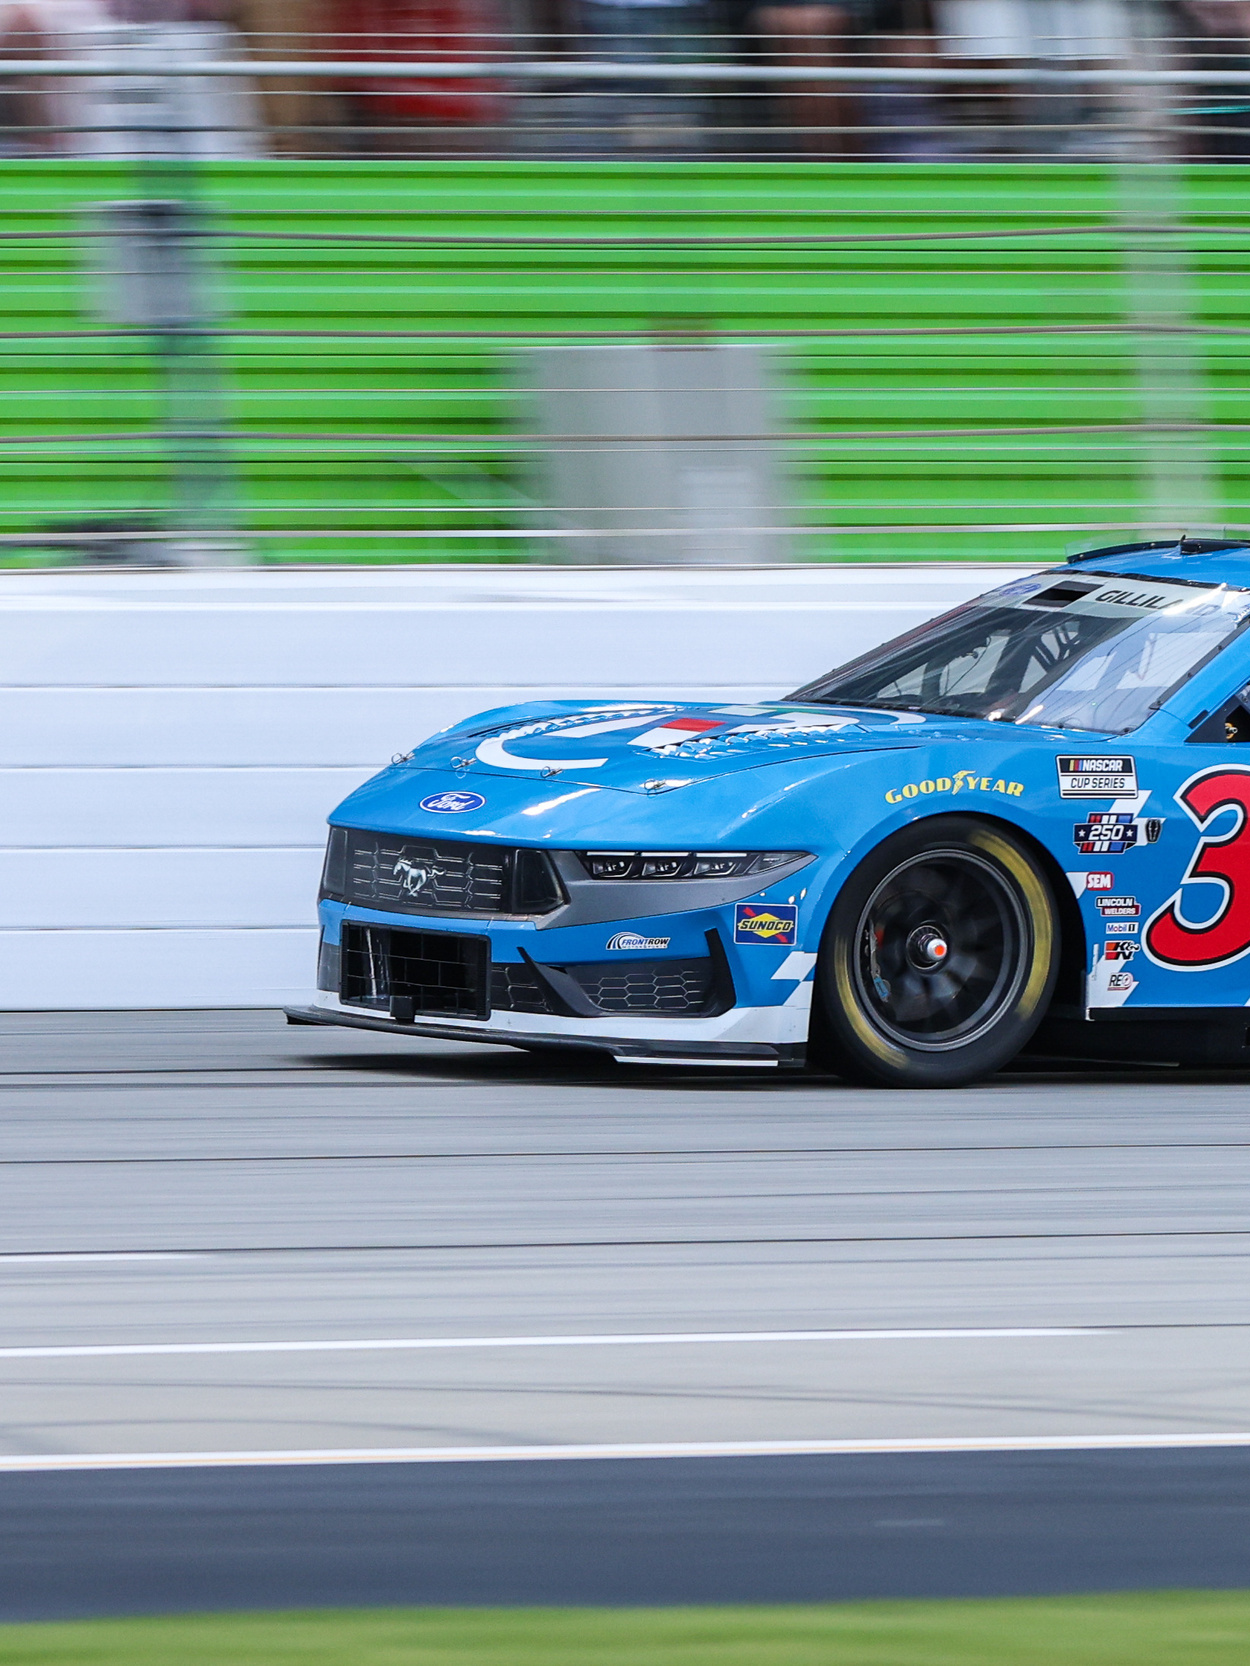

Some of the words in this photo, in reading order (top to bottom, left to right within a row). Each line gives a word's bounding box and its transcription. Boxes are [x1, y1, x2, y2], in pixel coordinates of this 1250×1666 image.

[1094, 589, 1221, 617] GILLILAD
[1082, 759, 1123, 771] NASCAR
[885, 770, 1025, 804] GOODYEAR
[1070, 778, 1090, 789] CUP
[1091, 778, 1125, 789] SERIES
[427, 793, 476, 811] Ford
[1088, 824, 1125, 840] 250
[1086, 874, 1112, 888] SEM
[1097, 898, 1133, 907] LINCOLN
[1104, 907, 1137, 915] WELDERS
[740, 919, 792, 932] SUNOCO
[1107, 924, 1127, 932] Mobil
